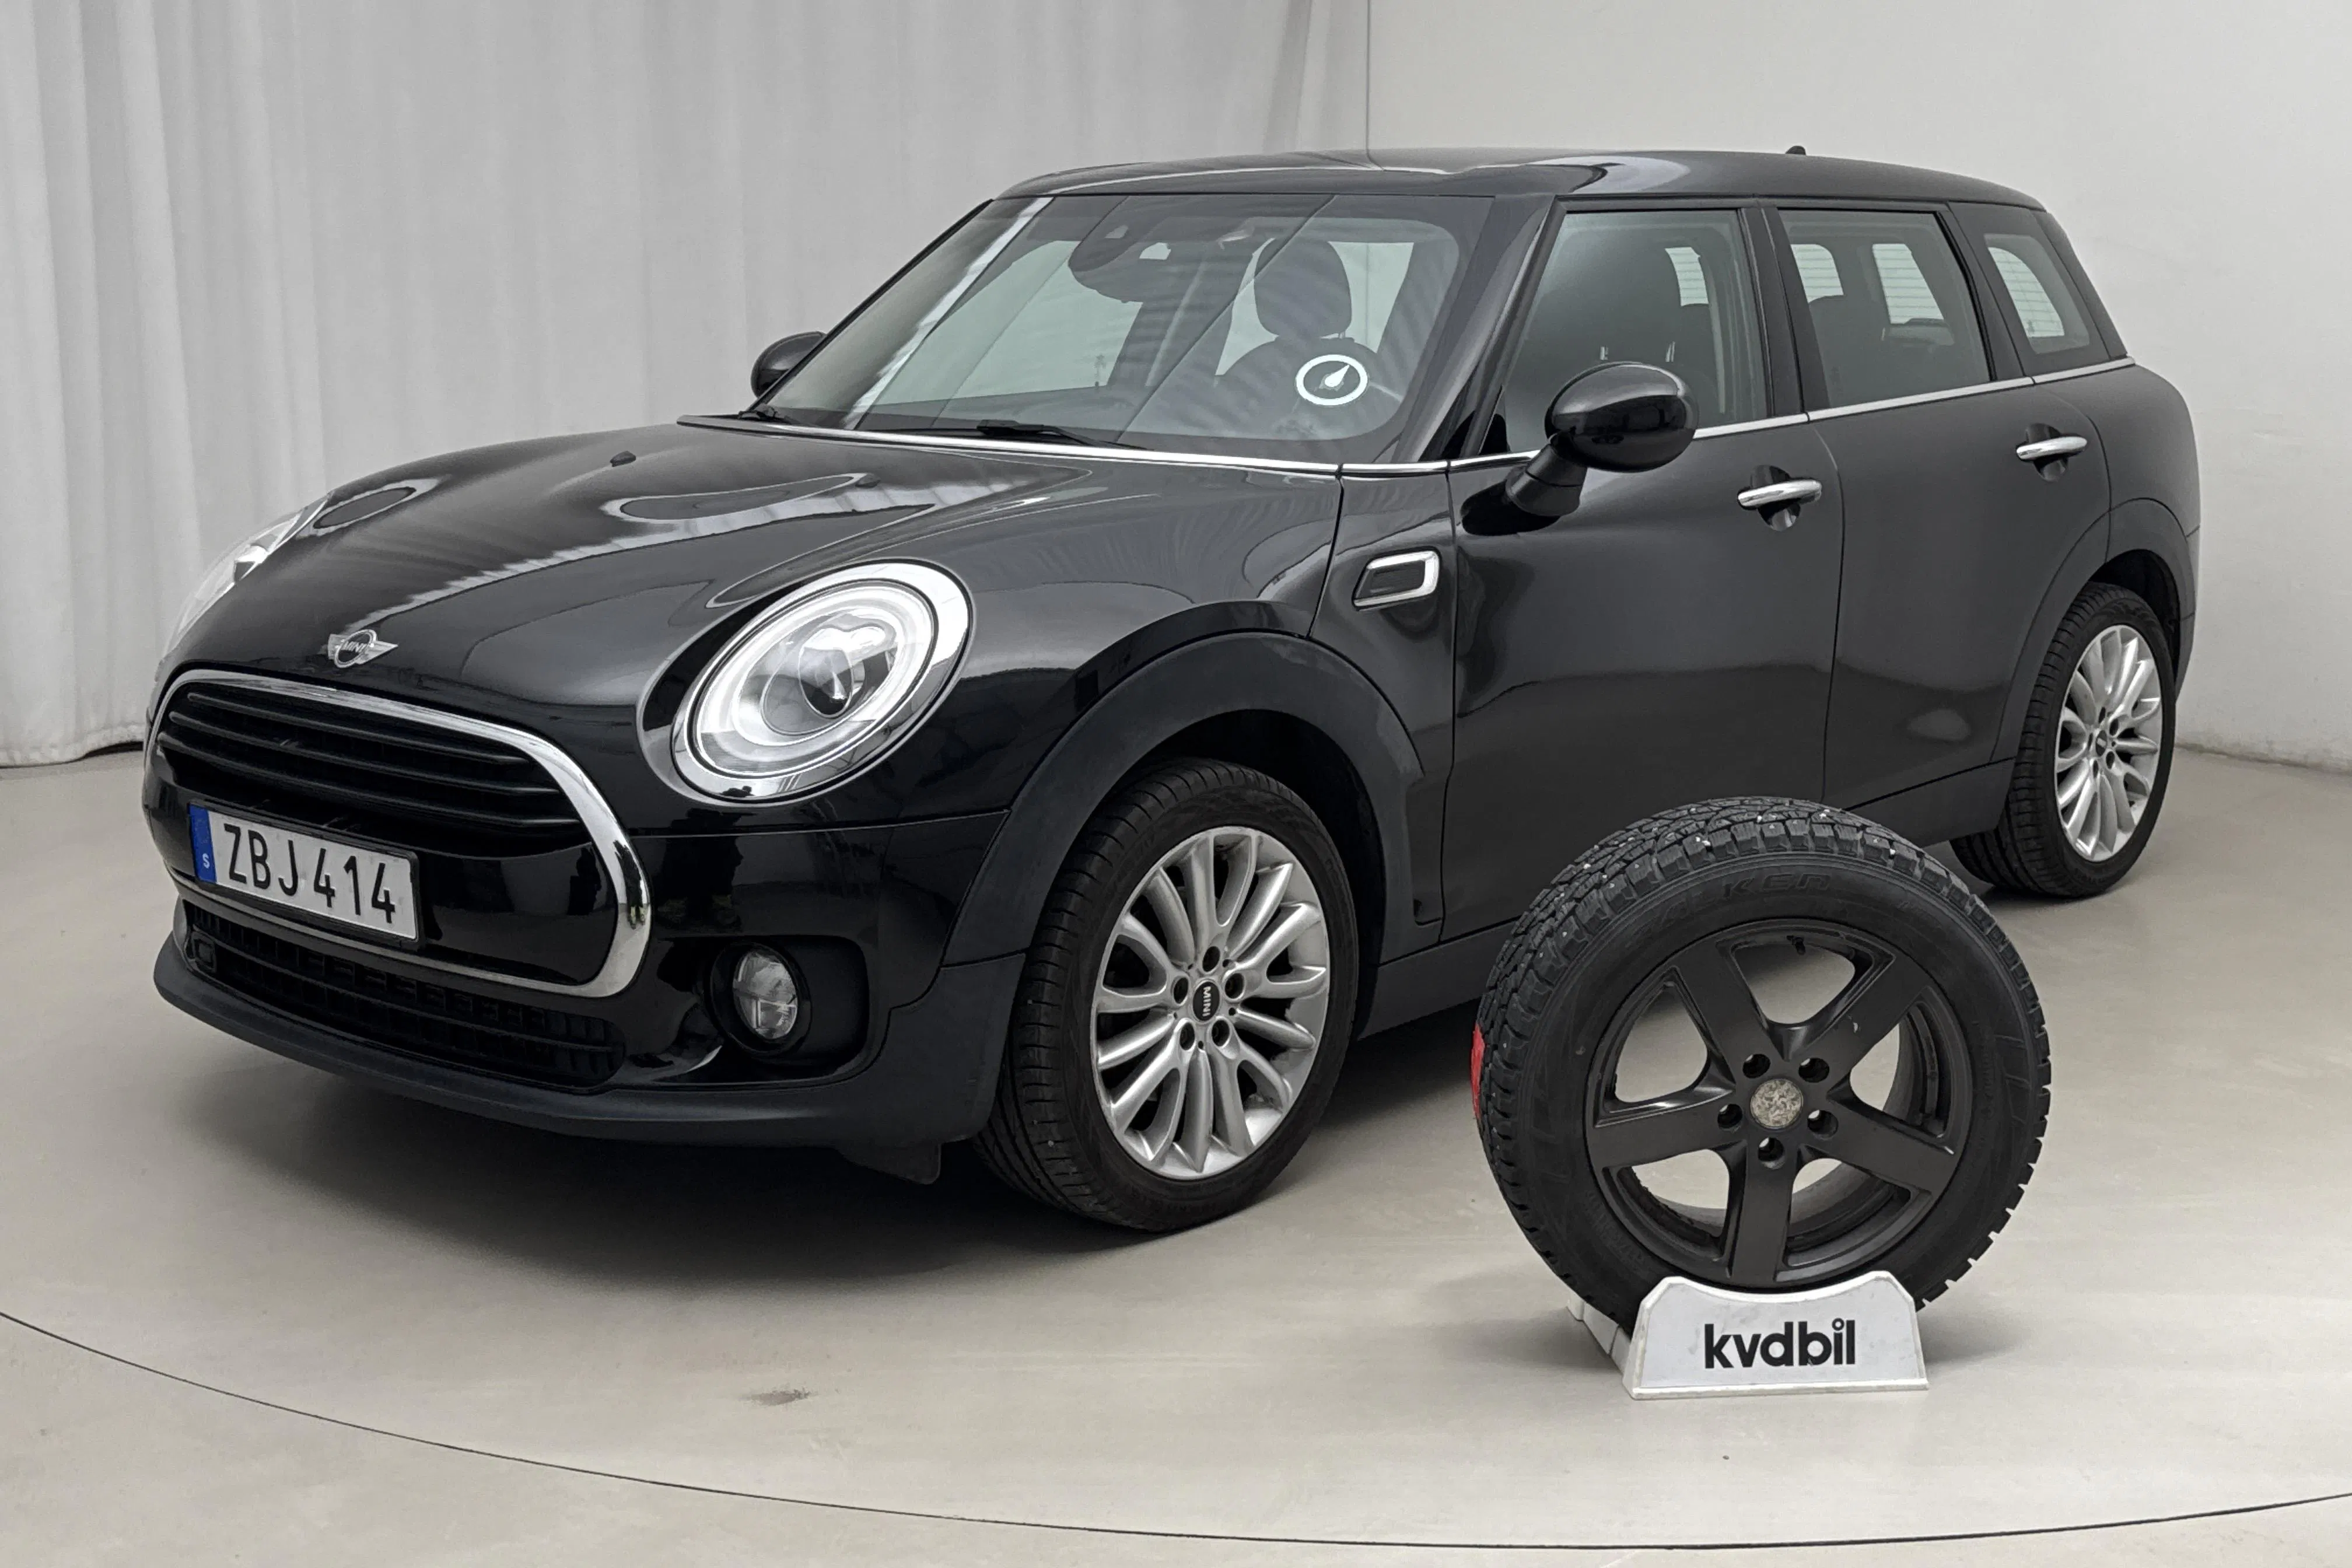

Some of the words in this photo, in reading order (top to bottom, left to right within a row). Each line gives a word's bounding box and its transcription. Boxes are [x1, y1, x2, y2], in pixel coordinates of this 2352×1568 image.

[202, 853, 210, 869] S
[223, 823, 298, 896] ZBJ
[314, 848, 396, 923] 414
[1202, 986, 1212, 1017] MINI
[1704, 1318, 1856, 1368] kvdbil
